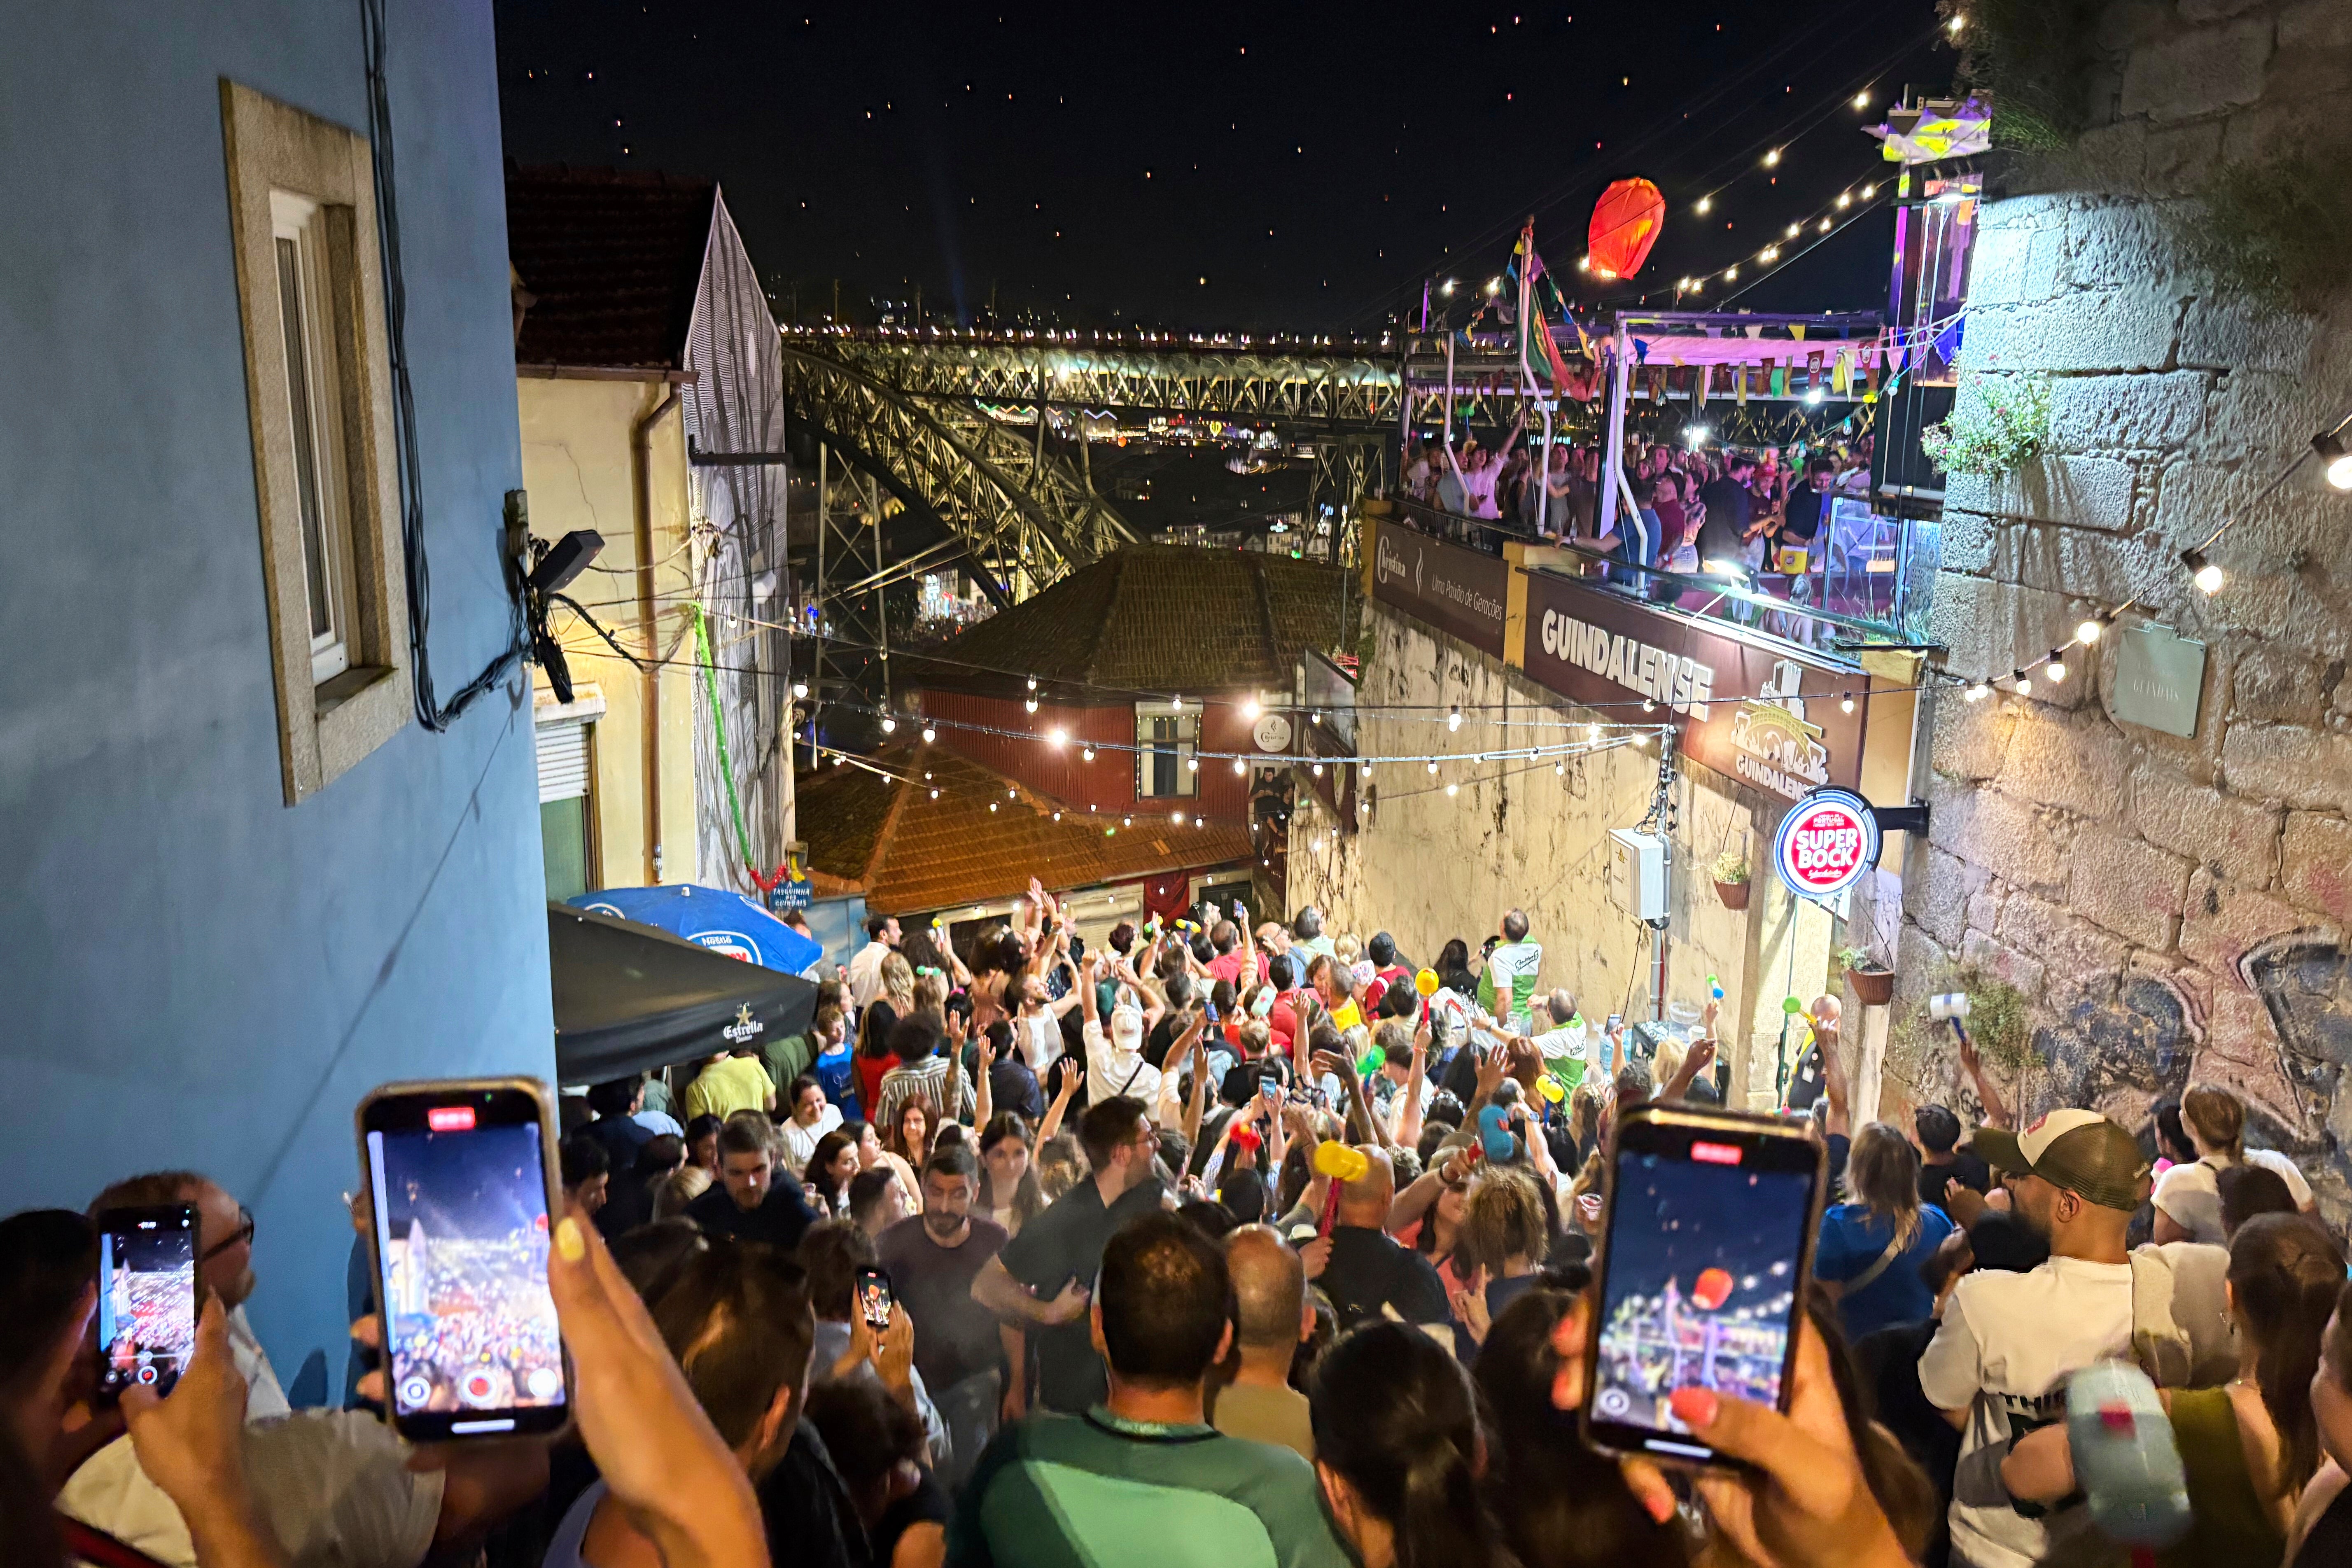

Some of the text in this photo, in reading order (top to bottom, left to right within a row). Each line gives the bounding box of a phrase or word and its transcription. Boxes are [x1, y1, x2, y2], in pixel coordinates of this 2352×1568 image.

[1377, 536, 1406, 584] Christina
[1432, 574, 1503, 621] Uma Paixão de Gerações
[1542, 609, 1712, 723] GUINDALENSE
[1796, 828, 1858, 850] SUPER
[1798, 847, 1854, 868] BOCK
[723, 1020, 763, 1040] Estrella
